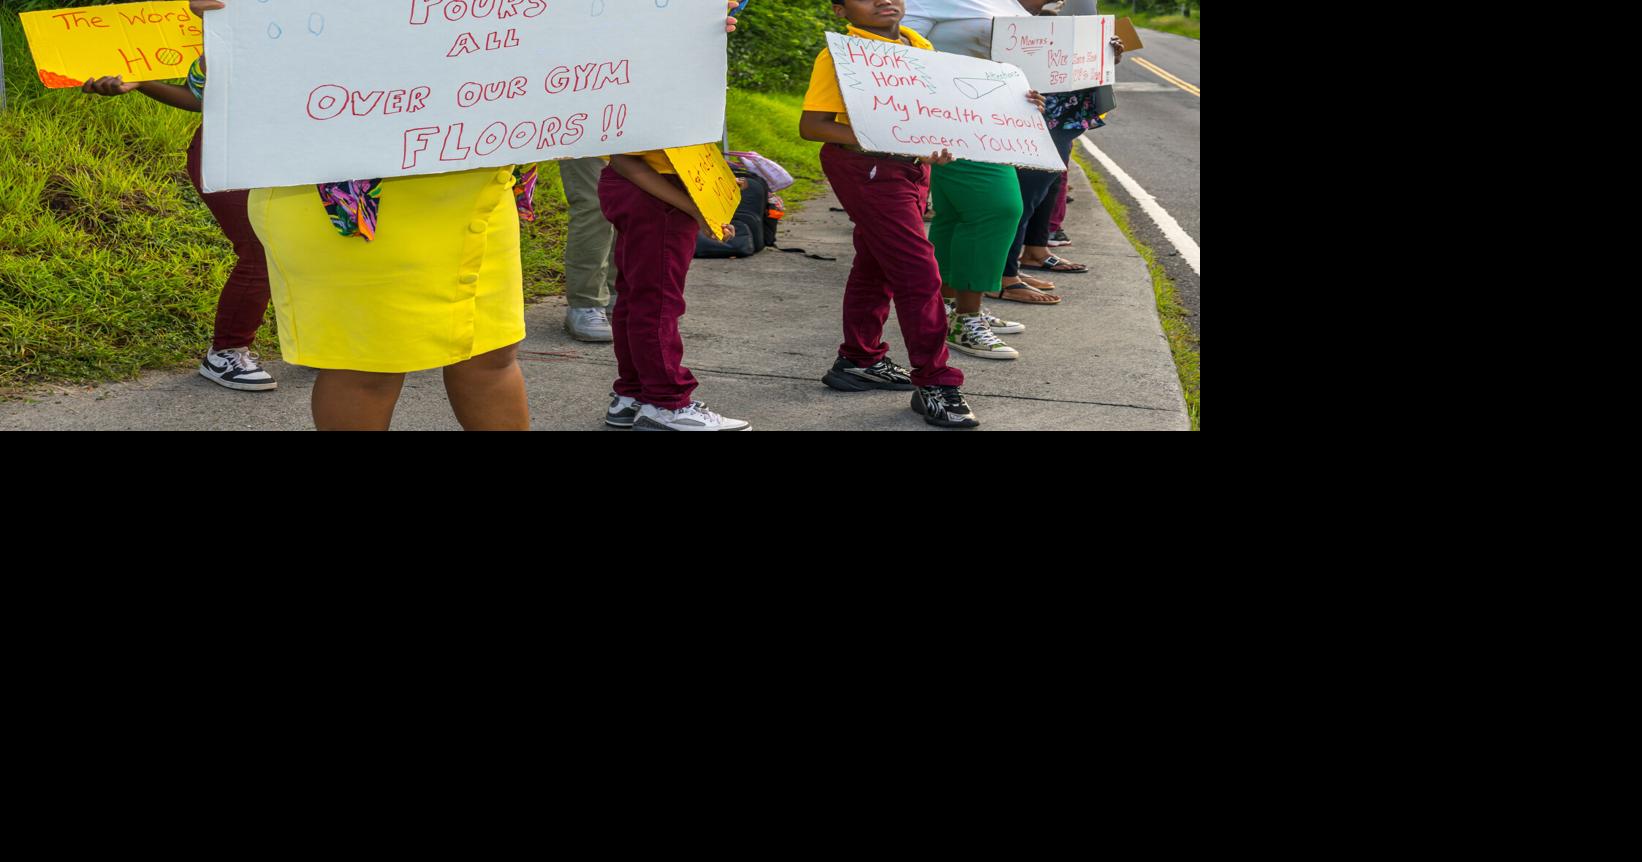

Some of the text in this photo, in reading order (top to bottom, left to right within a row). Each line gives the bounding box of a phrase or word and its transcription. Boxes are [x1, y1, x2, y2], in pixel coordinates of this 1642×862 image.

[52, 8, 191, 30] The Word
[179, 25, 202, 36] is
[446, 28, 520, 57] ALL
[1005, 23, 1018, 52] 3
[847, 43, 911, 71] Honk
[306, 59, 630, 120] OVER OUR GYM
[873, 95, 909, 122] My
[916, 99, 984, 126] health
[401, 112, 588, 169] FLOORS
[891, 125, 969, 149] Concern
